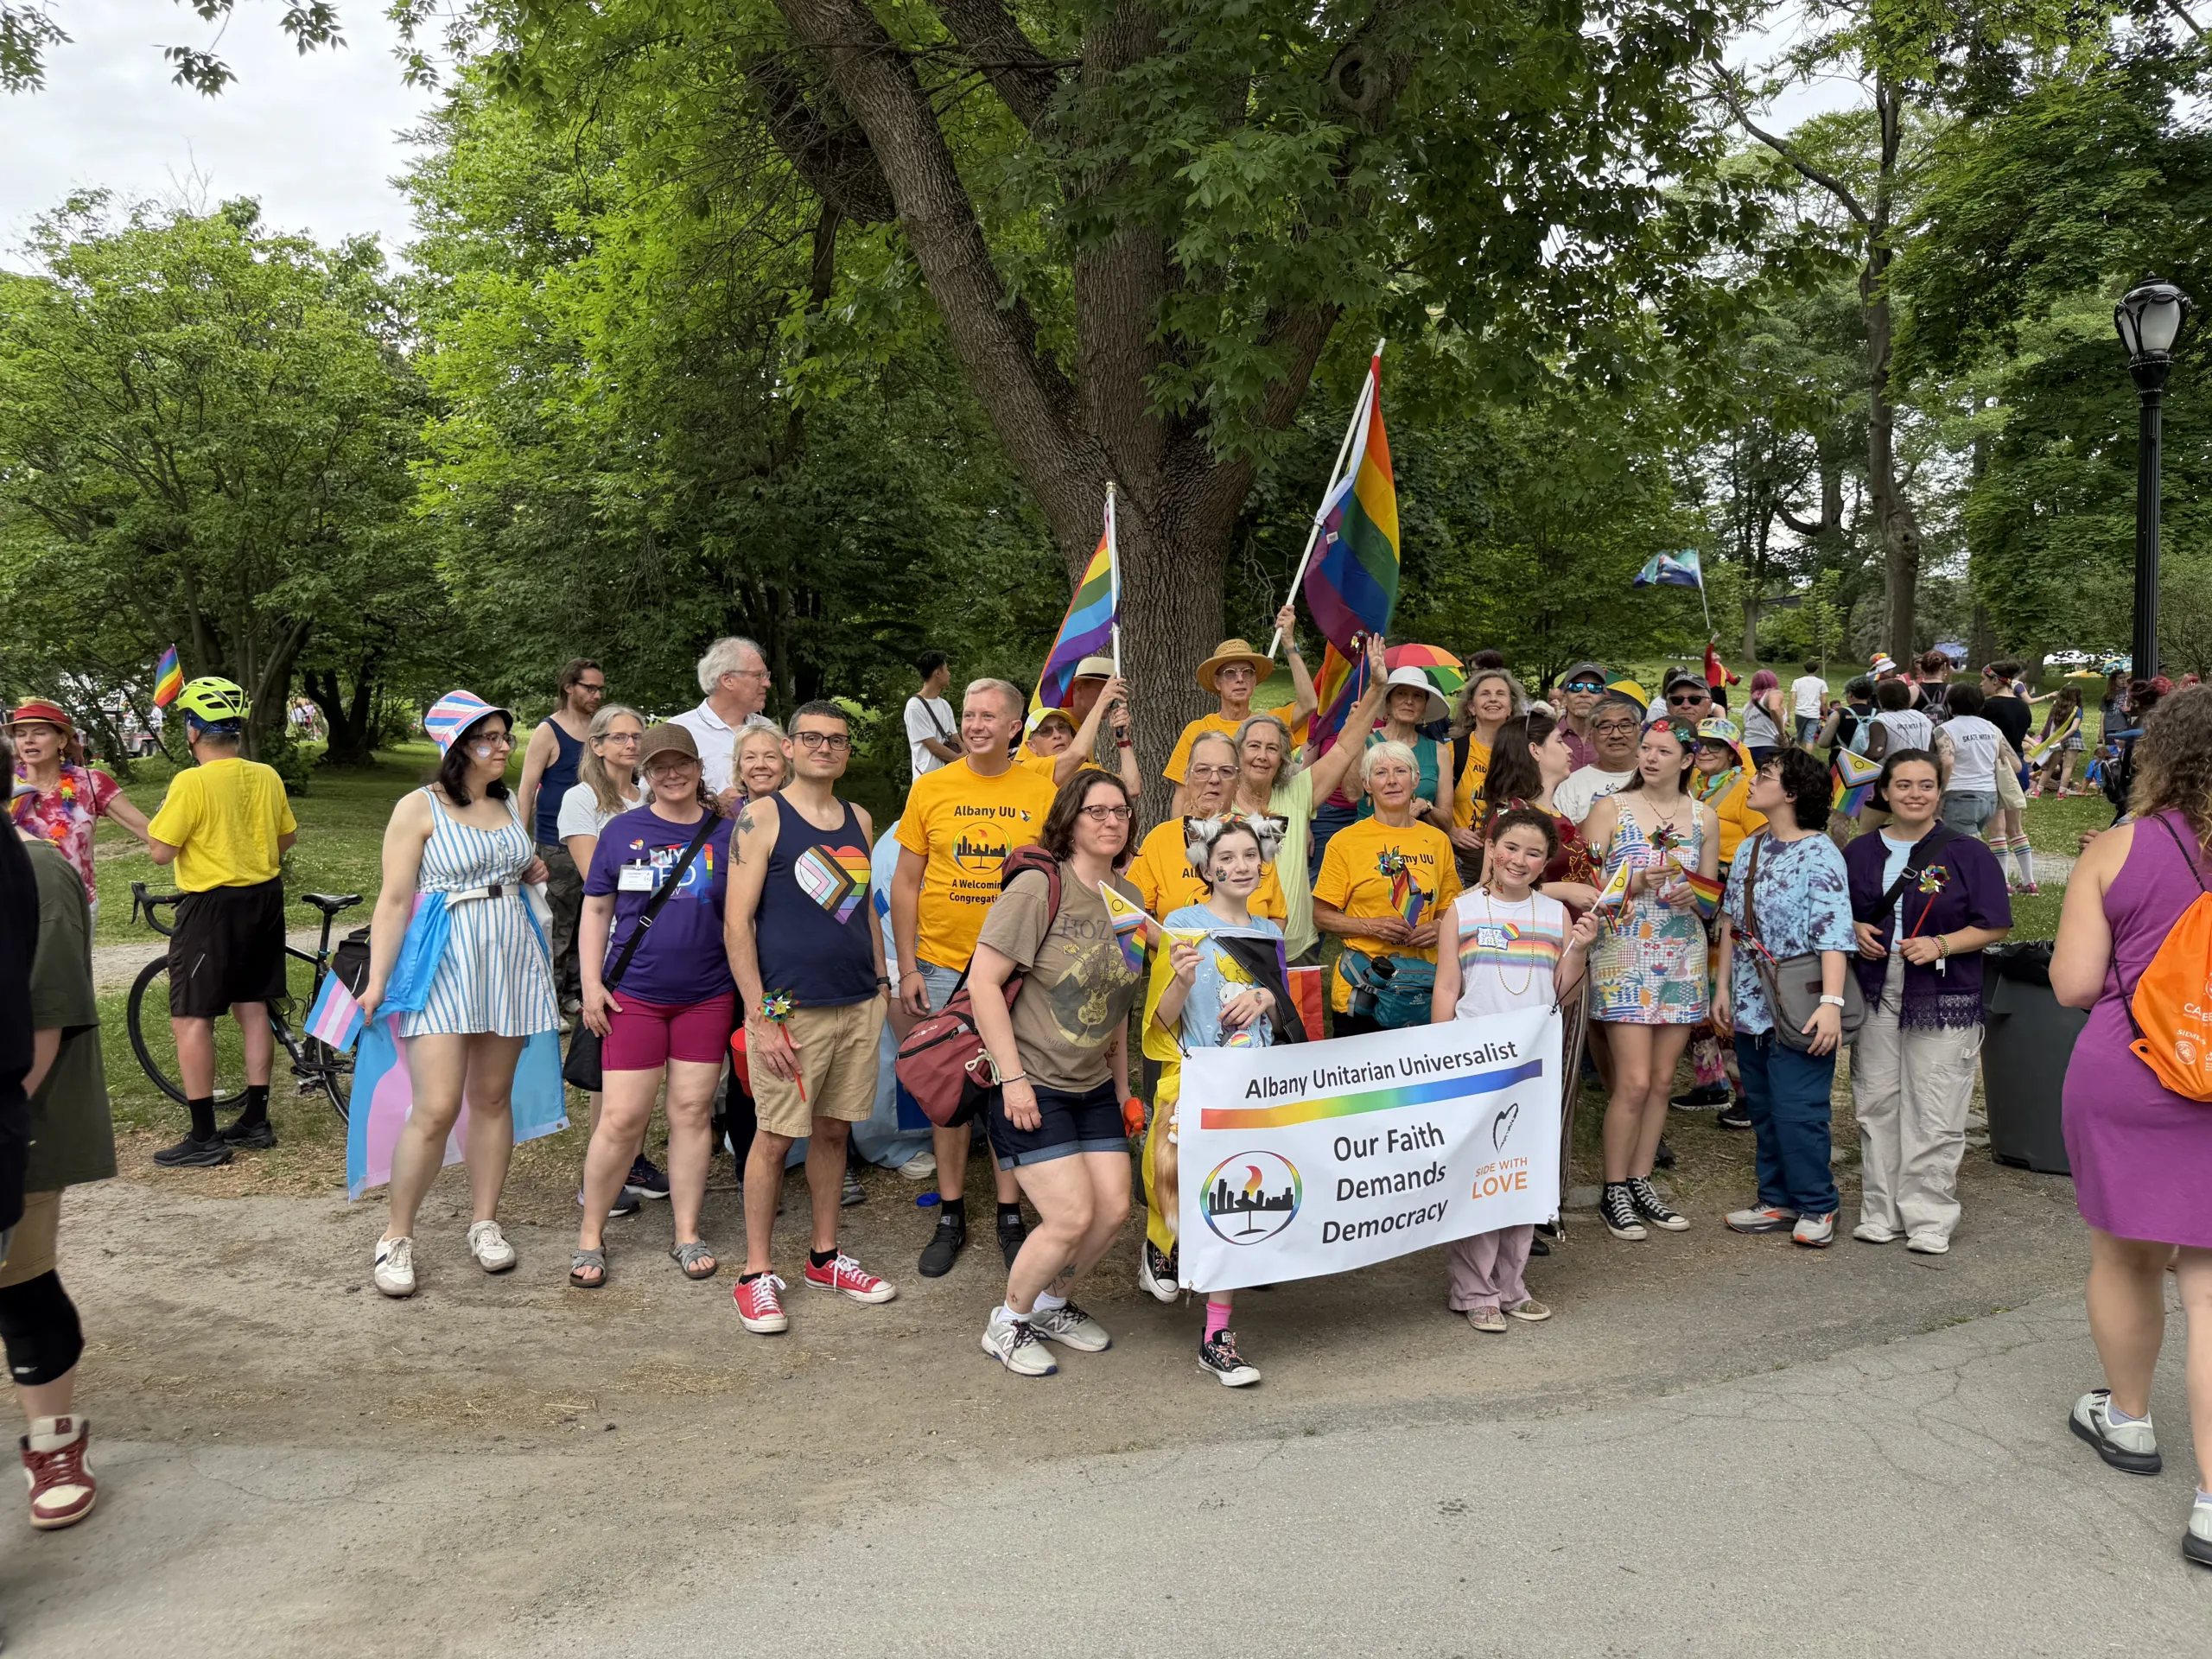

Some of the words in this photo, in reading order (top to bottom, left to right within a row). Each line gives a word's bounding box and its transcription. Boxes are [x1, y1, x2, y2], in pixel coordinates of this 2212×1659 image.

[1472, 764, 1487, 772] Alb
[954, 805, 996, 819] Albany
[999, 806, 1016, 817] UU
[659, 848, 696, 866] NY
[1420, 854, 1433, 864] UU
[951, 879, 957, 888] A
[959, 879, 1001, 889] Welcomin
[949, 892, 997, 905] Congregati
[1061, 917, 1116, 941] HOZ
[1245, 1076, 1307, 1098] Albany
[1313, 1062, 1395, 1089] Unitarian
[1399, 1041, 1518, 1076] Universalist
[1333, 1136, 1379, 1161] Our
[1387, 1122, 1445, 1154] Faith
[1475, 1162, 1496, 1177] SIDE
[1499, 1157, 1528, 1170] WITH
[1337, 1161, 1446, 1201] Demands
[1471, 1171, 1528, 1199] LOVE
[1322, 1199, 1448, 1244] Democracy
